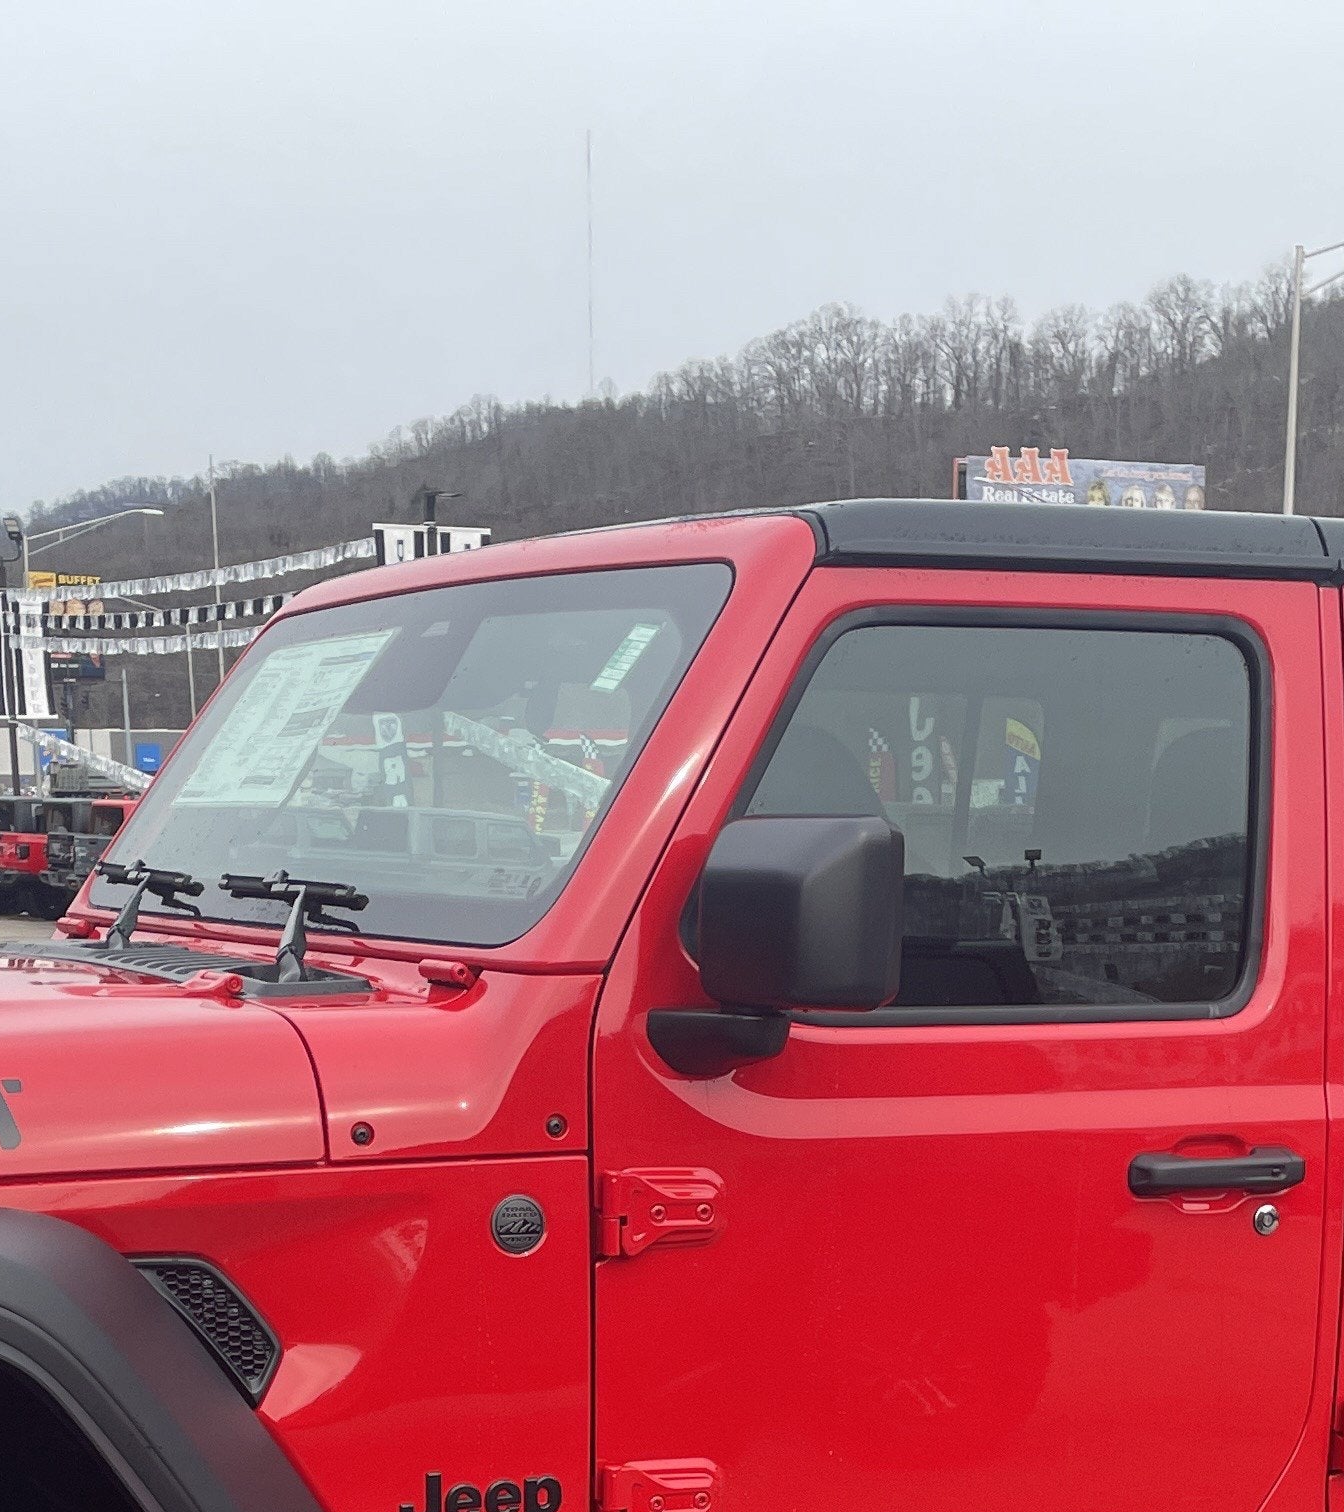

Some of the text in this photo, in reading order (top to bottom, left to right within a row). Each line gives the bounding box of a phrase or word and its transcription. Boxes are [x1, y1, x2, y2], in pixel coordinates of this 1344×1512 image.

[984, 446, 1074, 486] AAA
[982, 486, 1075, 504] Real Estate
[58, 575, 101, 586] BUFFET
